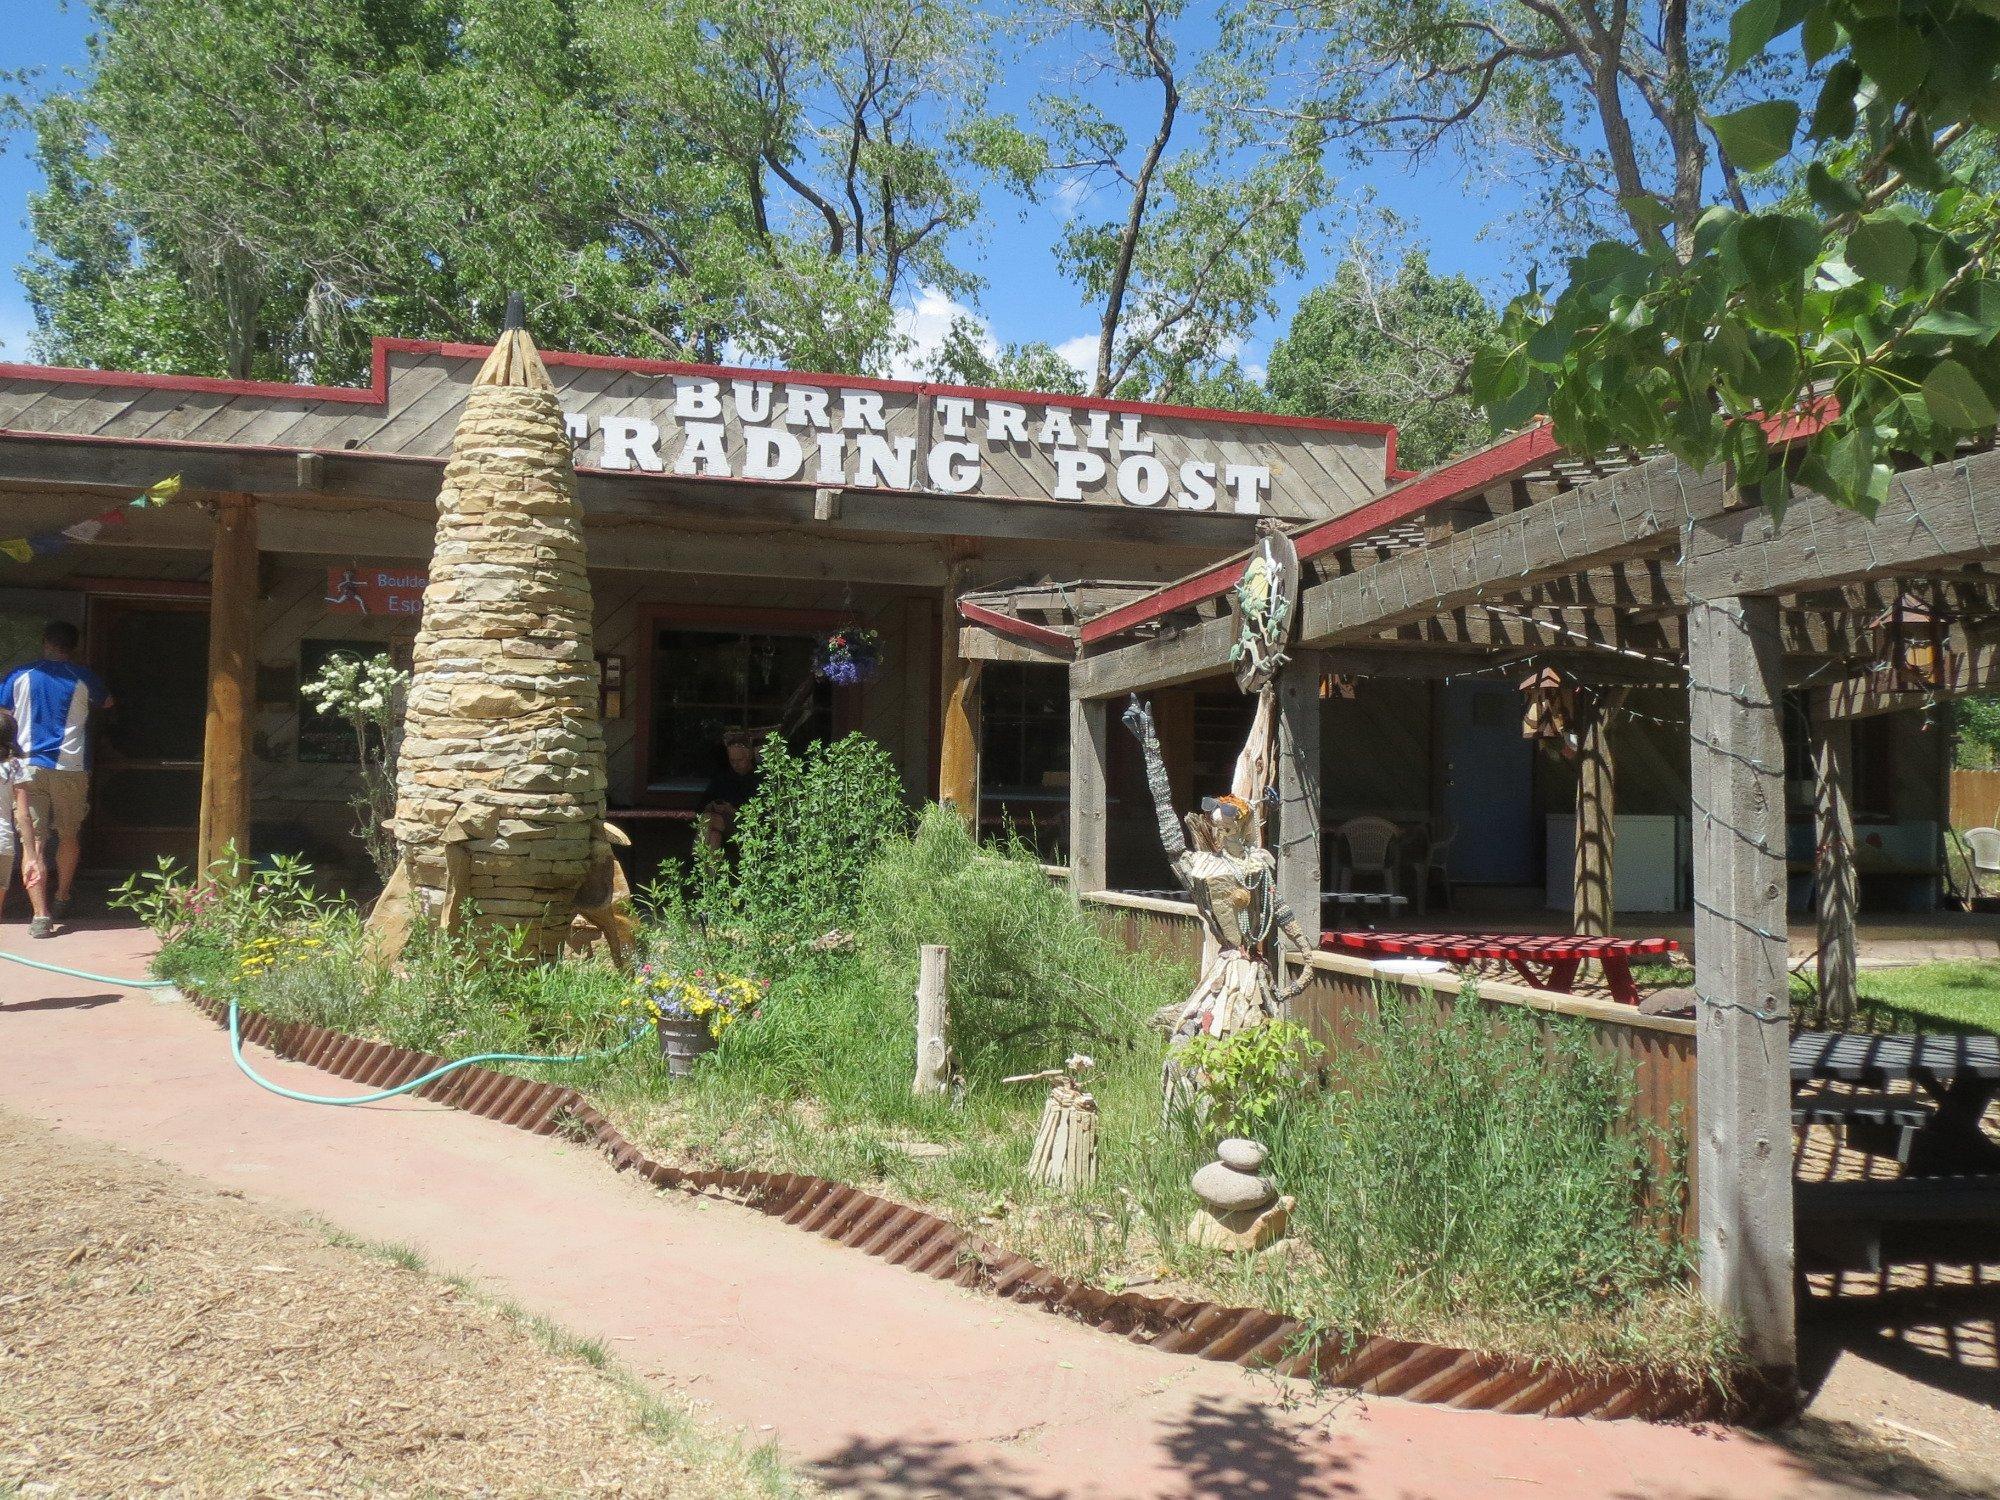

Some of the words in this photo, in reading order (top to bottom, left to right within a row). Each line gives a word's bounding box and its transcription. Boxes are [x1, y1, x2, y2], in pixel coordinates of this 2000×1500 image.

[673, 376, 886, 430] BURR
[937, 397, 1154, 452] TRAIL
[1054, 450, 1270, 515] POST
